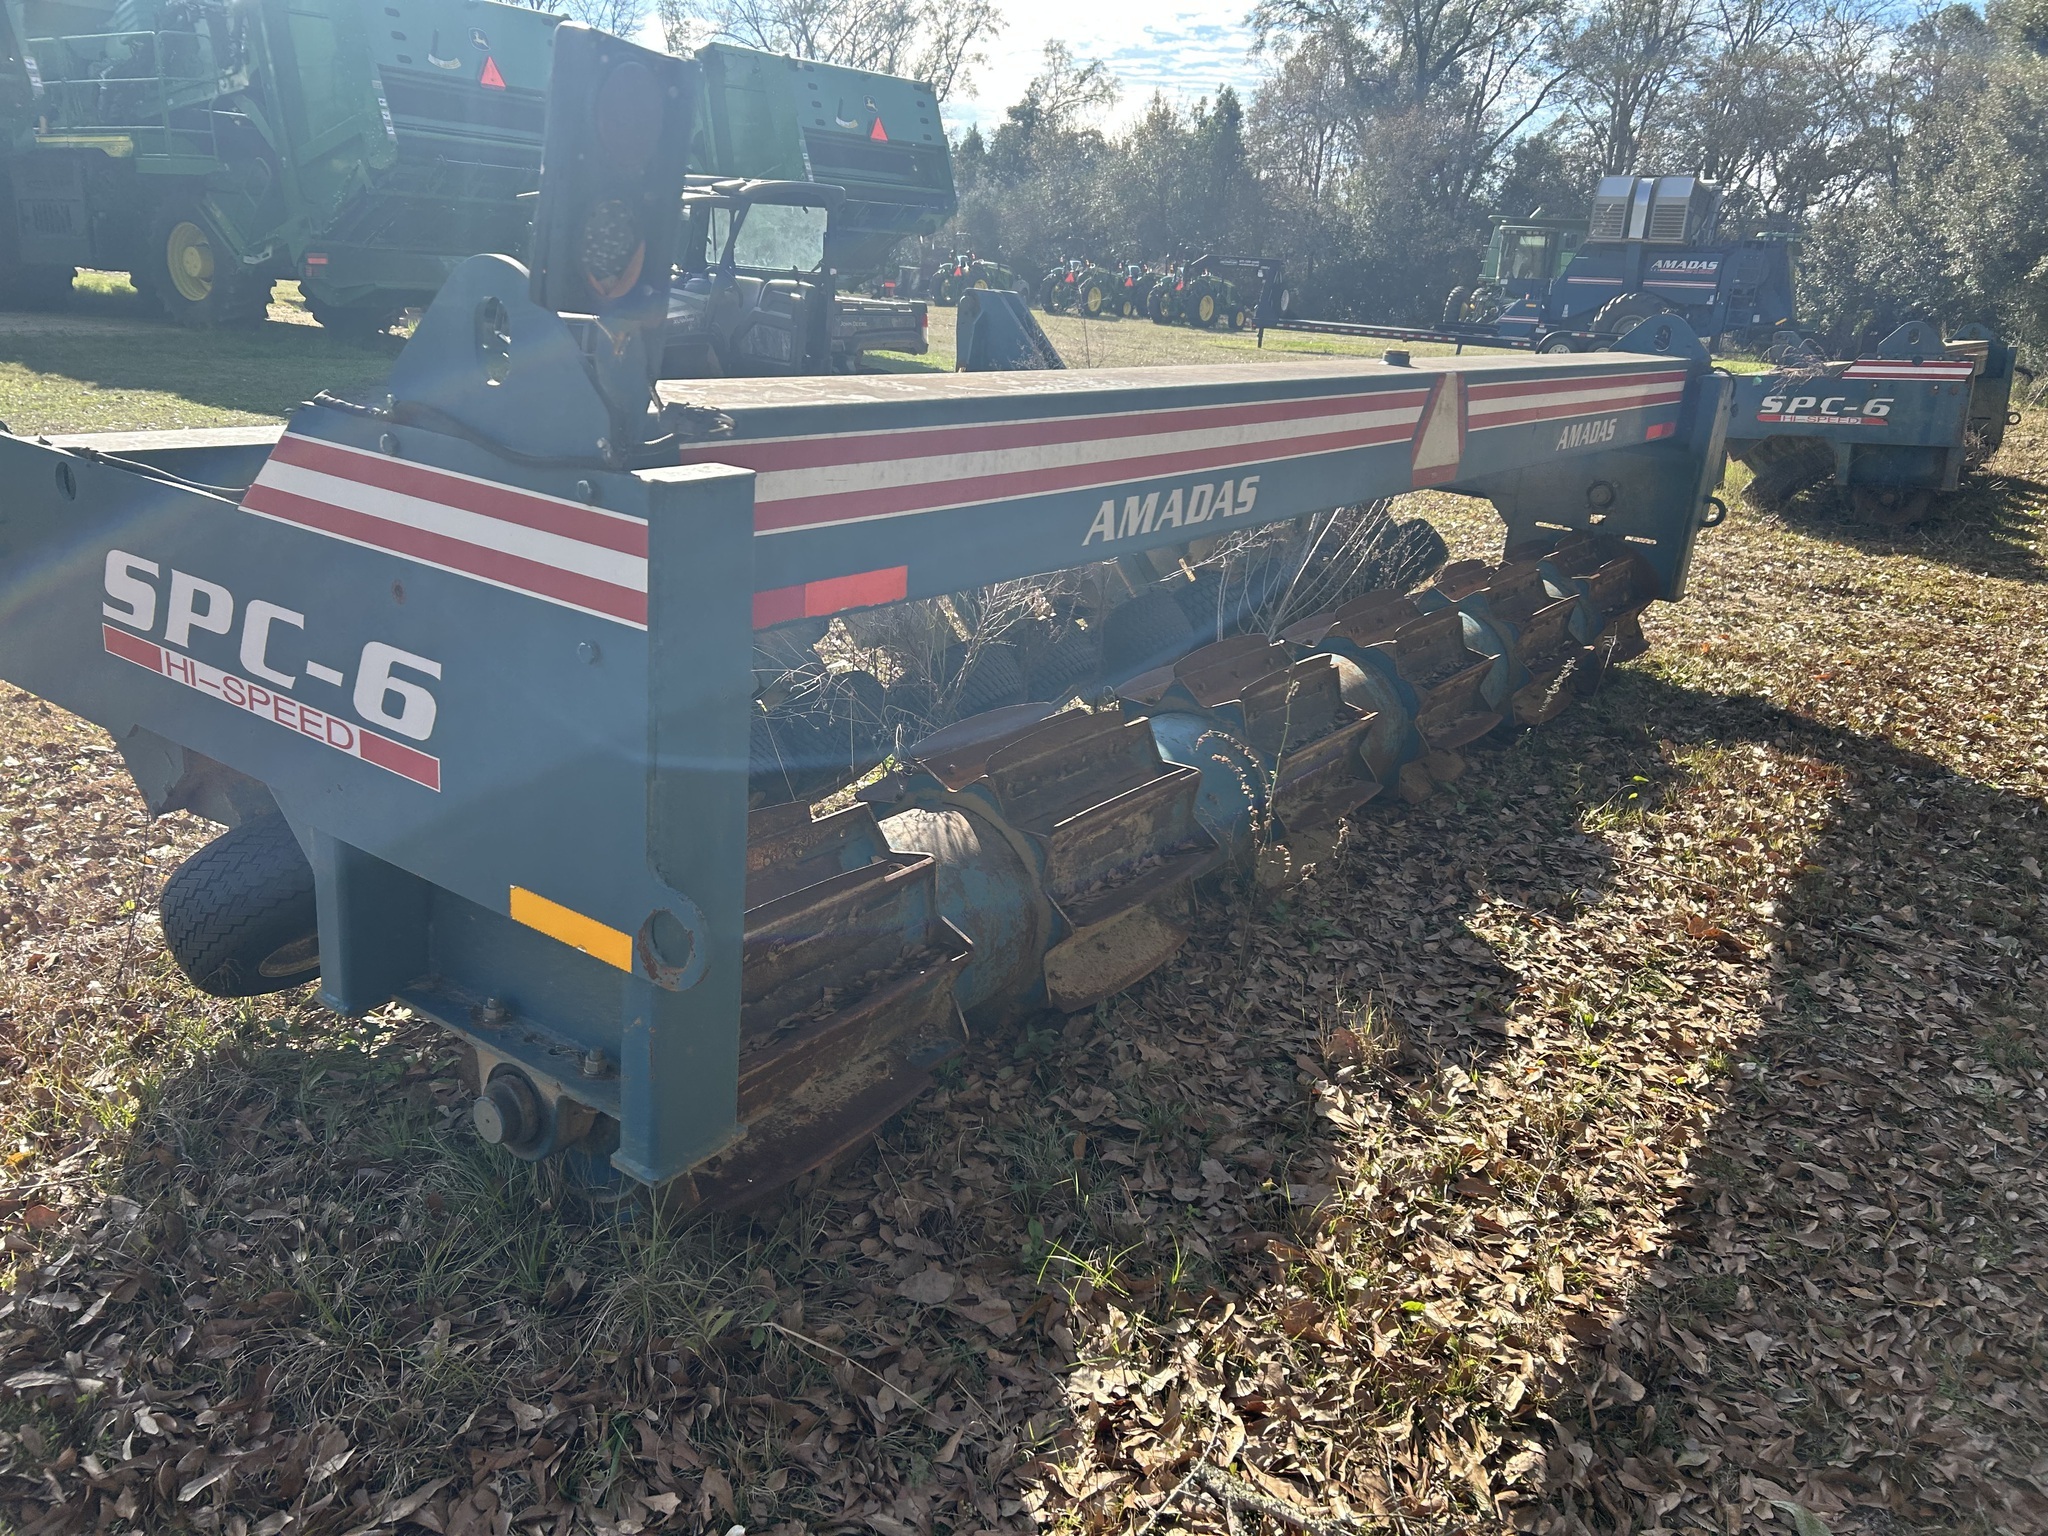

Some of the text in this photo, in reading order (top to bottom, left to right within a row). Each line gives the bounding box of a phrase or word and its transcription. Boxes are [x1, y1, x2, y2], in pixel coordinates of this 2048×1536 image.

[1651, 260, 1719, 270] AMADAS
[1760, 395, 1894, 417] SPC-6
[1782, 415, 1860, 425] HI-SPEED
[1556, 418, 1617, 451] AMADAS
[1081, 475, 1260, 546] AMADAS
[102, 549, 442, 741] SPC-6
[164, 650, 355, 751] HI-SPEED
